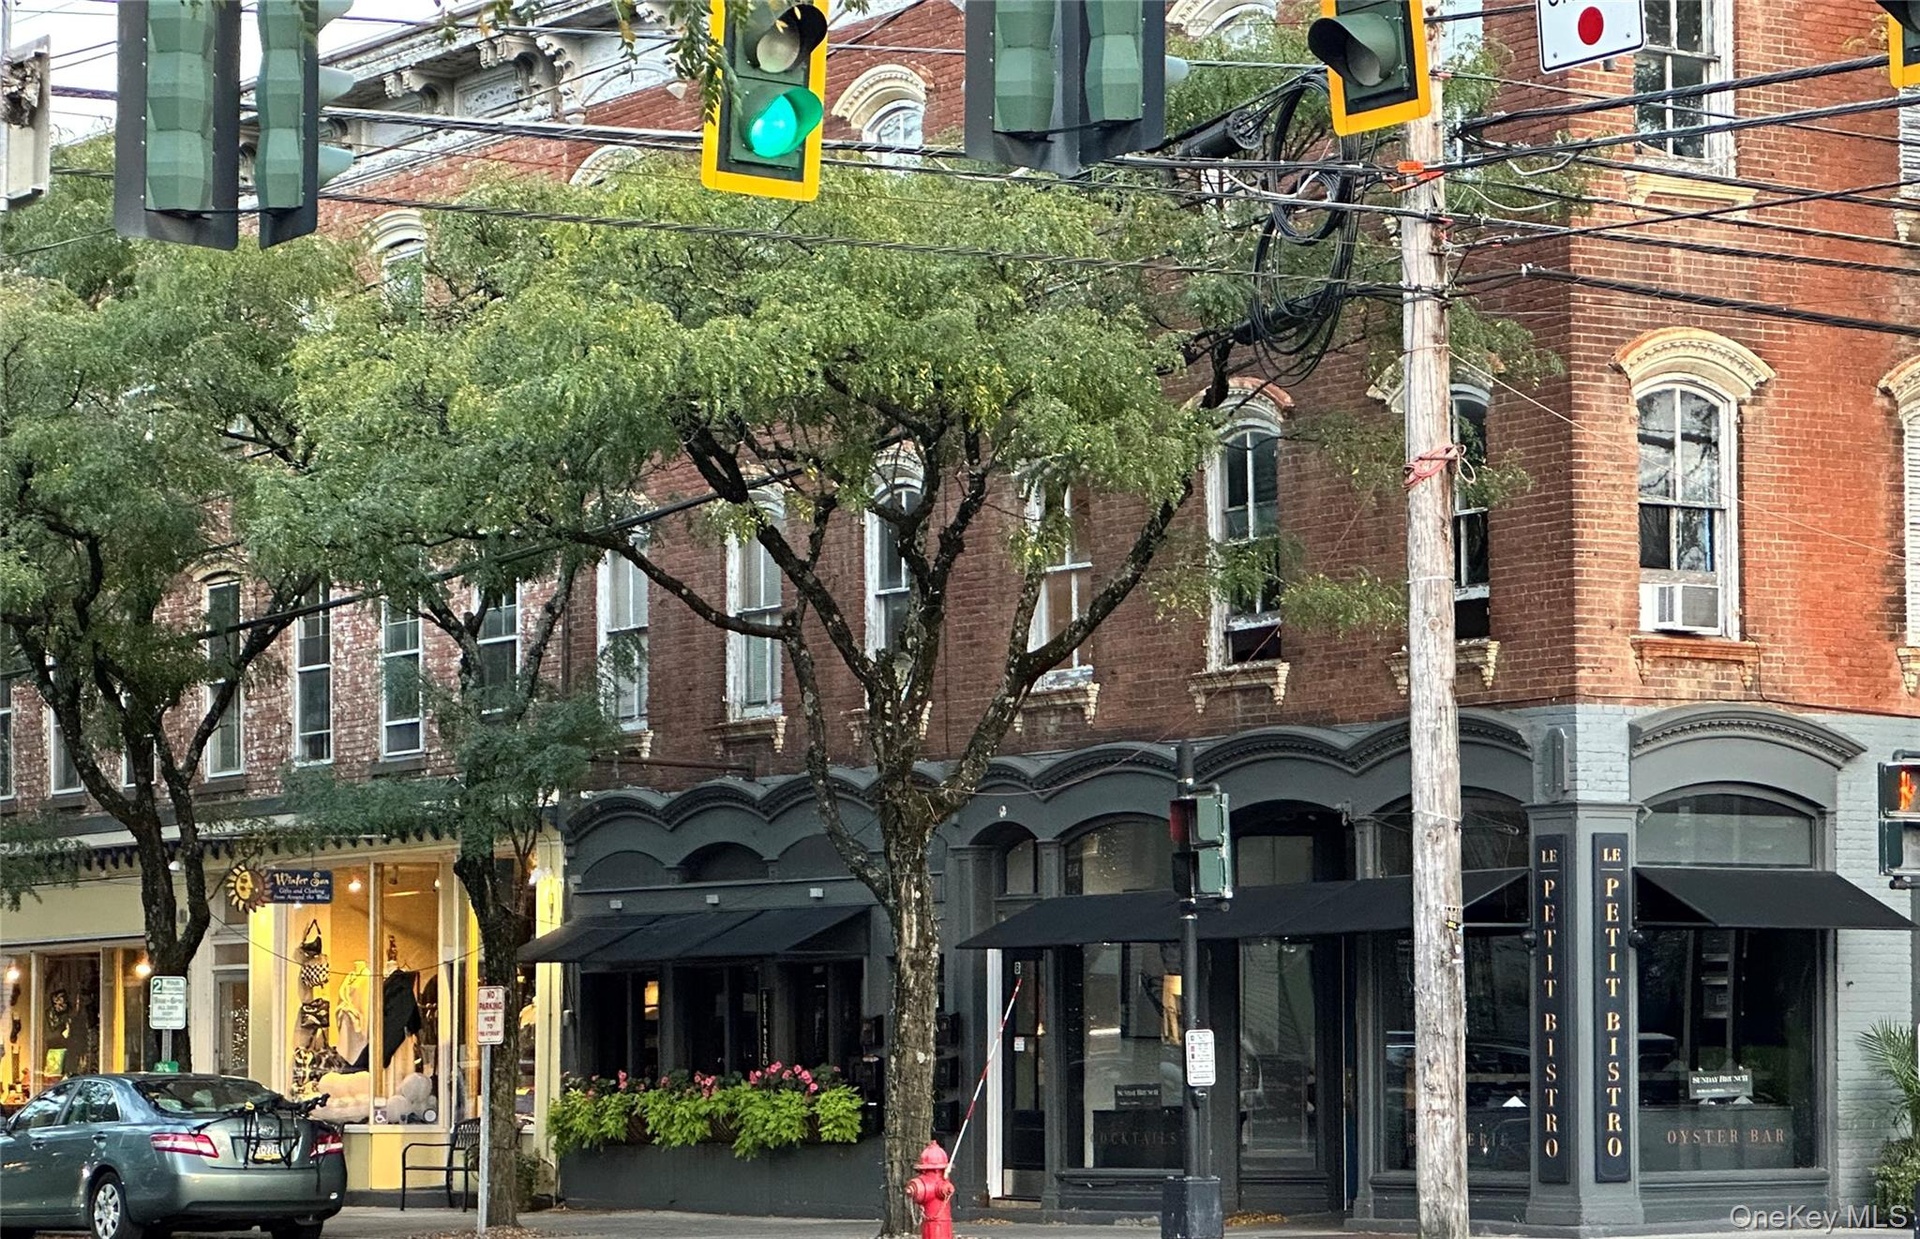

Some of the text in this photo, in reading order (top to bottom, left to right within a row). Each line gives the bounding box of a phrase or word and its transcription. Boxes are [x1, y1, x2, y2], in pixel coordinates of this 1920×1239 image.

[1541, 849, 1557, 863] LE
[1603, 848, 1621, 862] LE
[273, 871, 330, 887] Winter Sun
[153, 979, 162, 993] 2
[487, 991, 496, 999] NO
[479, 1002, 503, 1010] PARKING
[1543, 878, 1558, 1158] PETIT BISTRO
[1605, 877, 1622, 1157] PETIT BISTRO
[1692, 1074, 1749, 1084] SUNDAY BRUNCH
[1667, 1127, 1785, 1145] OYSTER BAR
